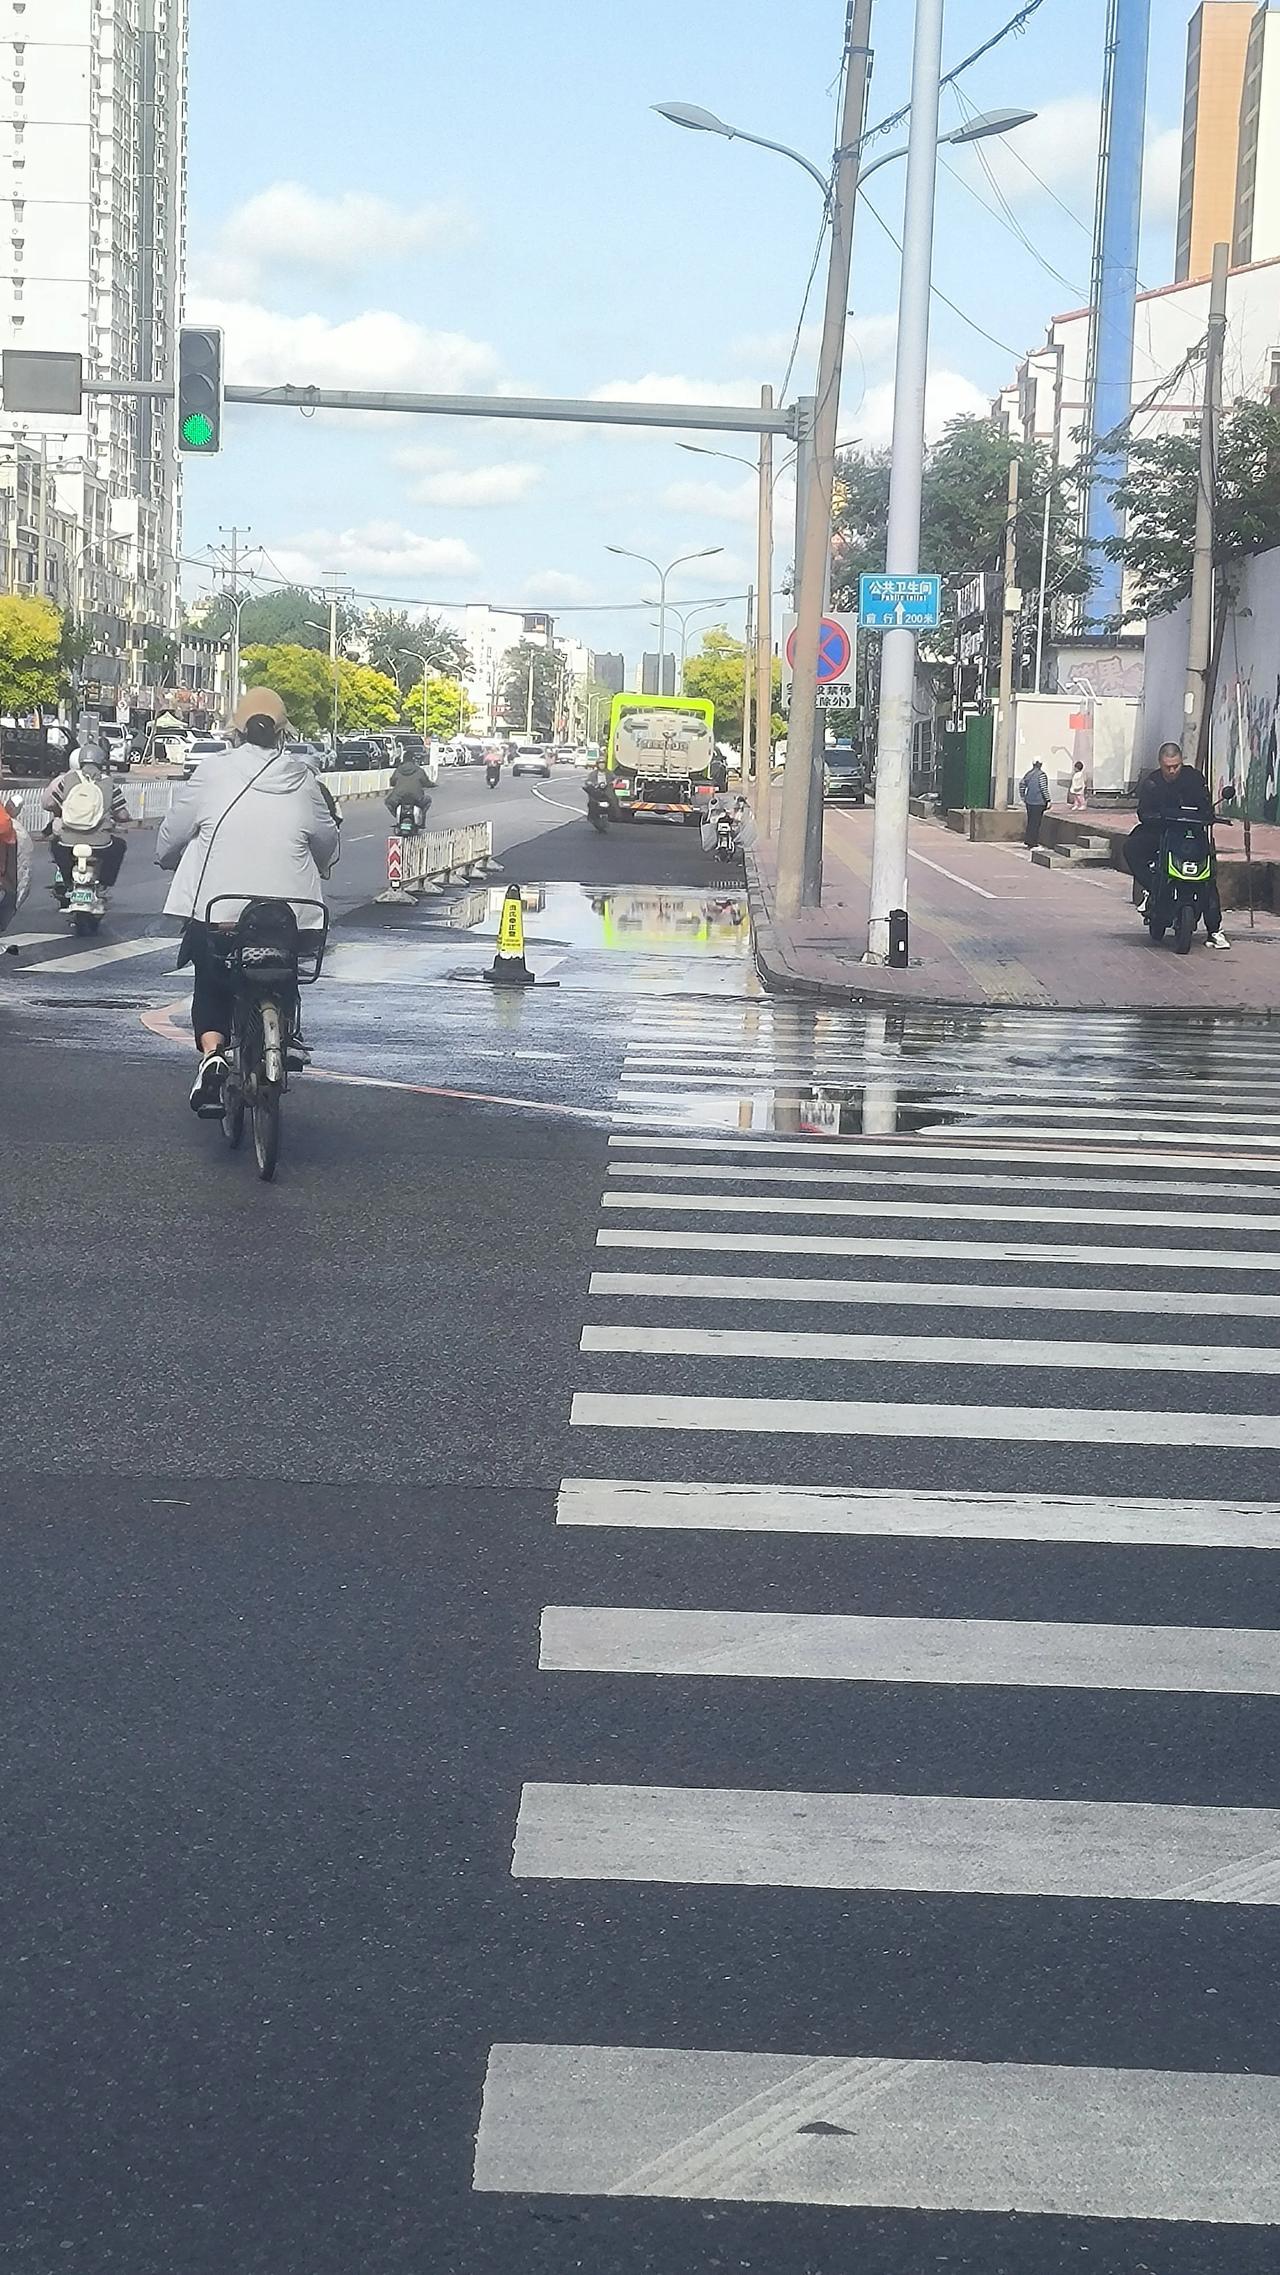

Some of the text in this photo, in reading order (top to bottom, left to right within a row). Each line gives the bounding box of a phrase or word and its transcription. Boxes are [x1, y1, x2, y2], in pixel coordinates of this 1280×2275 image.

[869, 581, 932, 595] 公共卫生间
[905, 613, 933, 624] 200米
